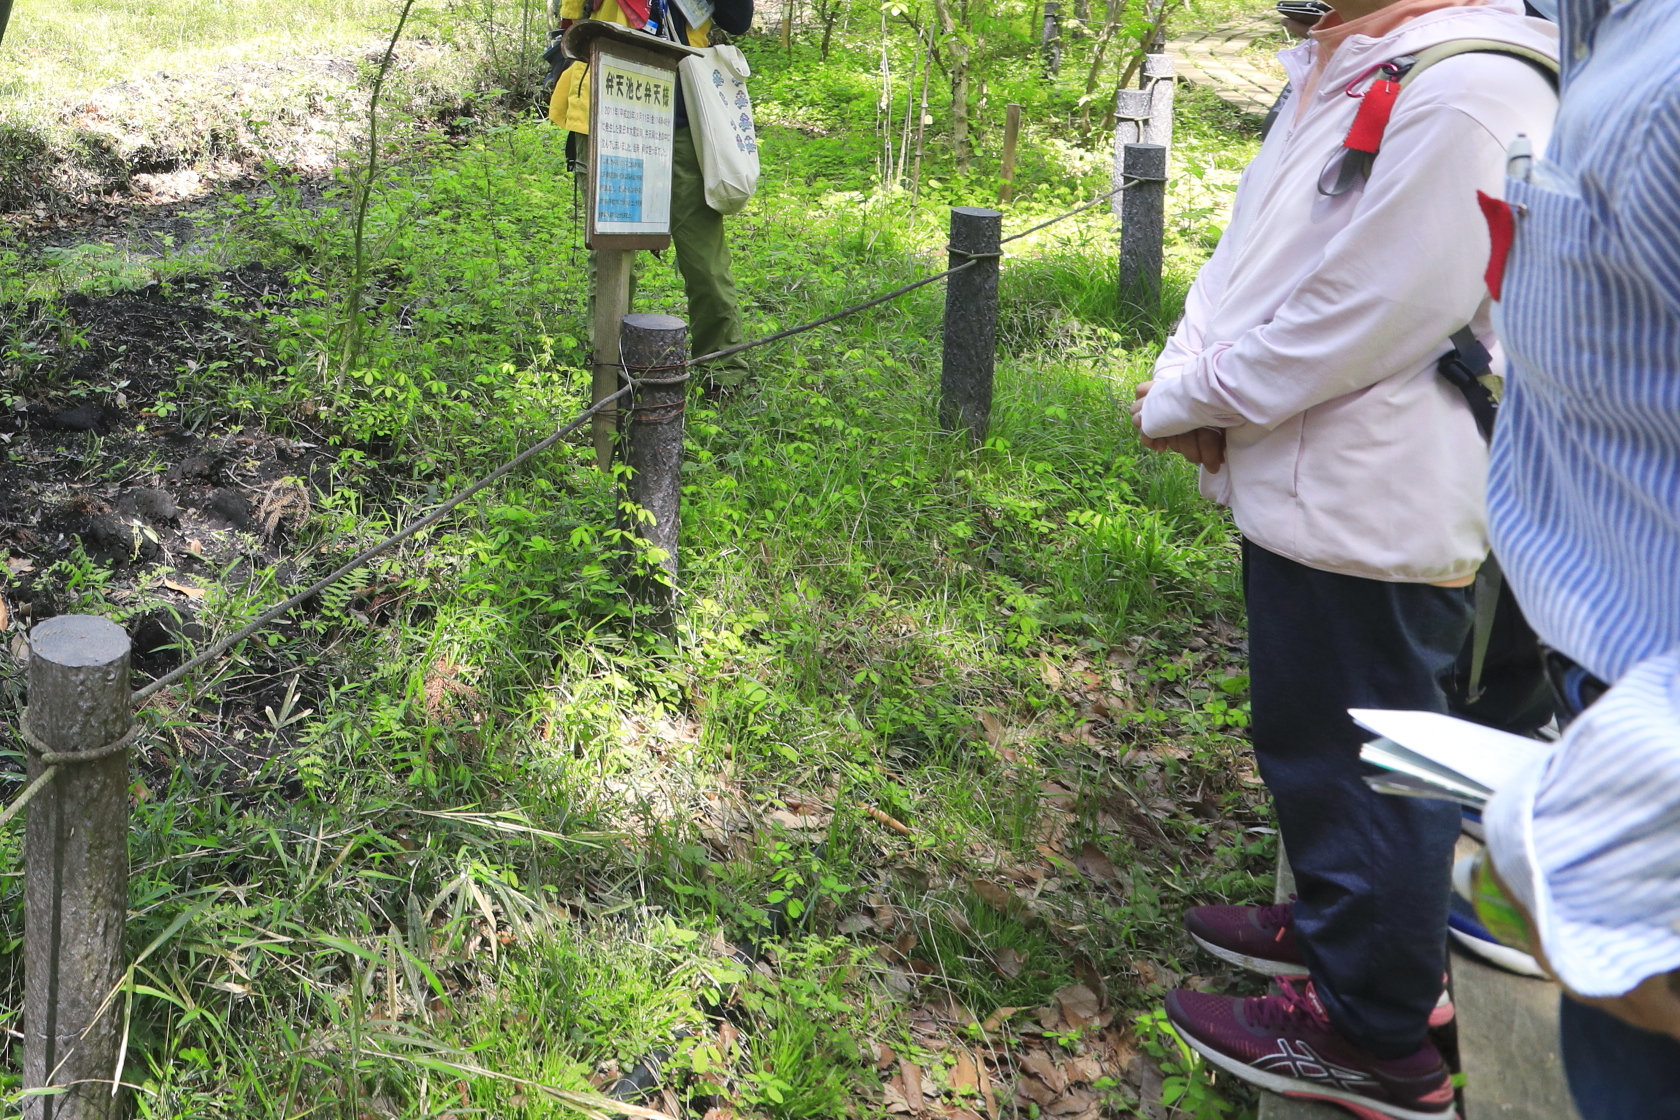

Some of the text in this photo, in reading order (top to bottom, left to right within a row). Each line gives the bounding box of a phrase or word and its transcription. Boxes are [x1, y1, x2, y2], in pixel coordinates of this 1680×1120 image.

[605, 71, 670, 108] 弁天池と弁天様
